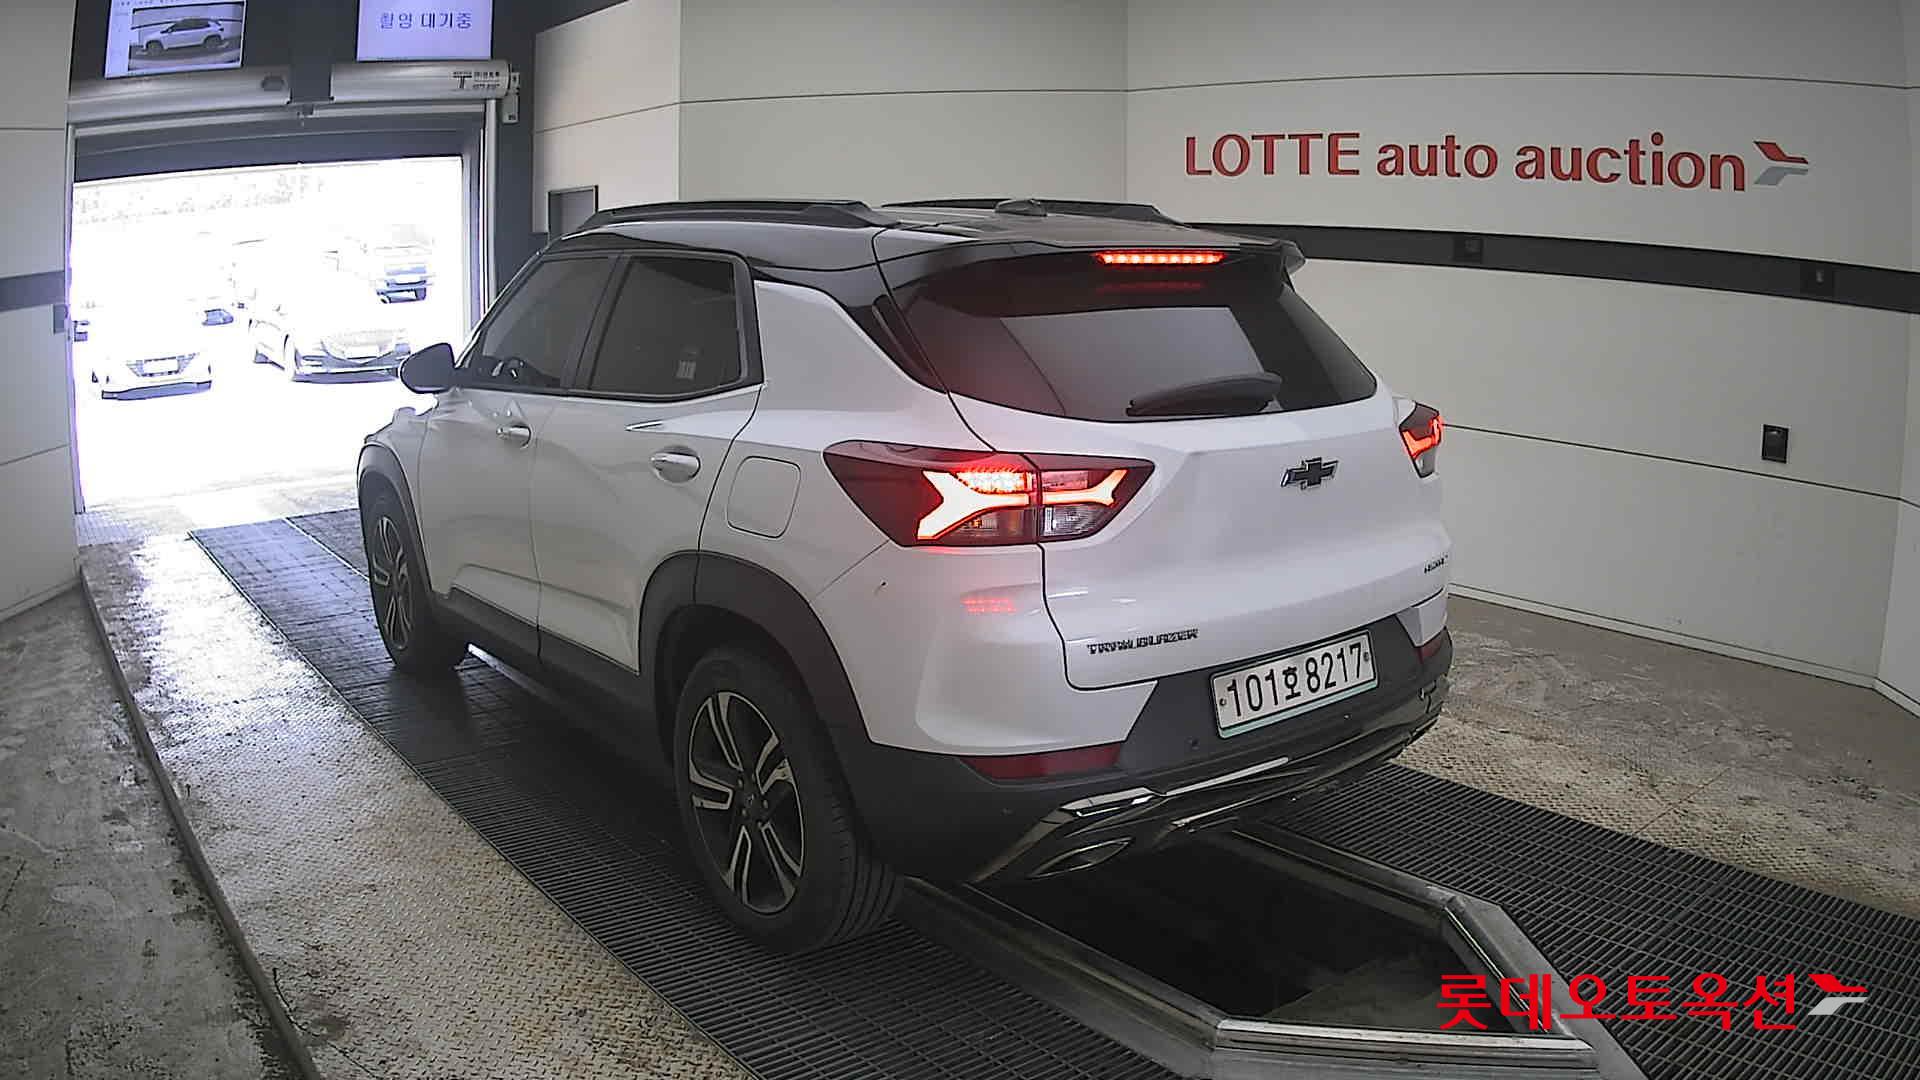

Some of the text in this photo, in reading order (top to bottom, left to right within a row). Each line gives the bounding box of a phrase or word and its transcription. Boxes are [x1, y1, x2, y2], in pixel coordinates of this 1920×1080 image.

[420, 12, 472, 29] 대기중
[1185, 132, 1746, 192] LOTTE auto auction
[1086, 628, 1198, 654] TRAILBLAZER
